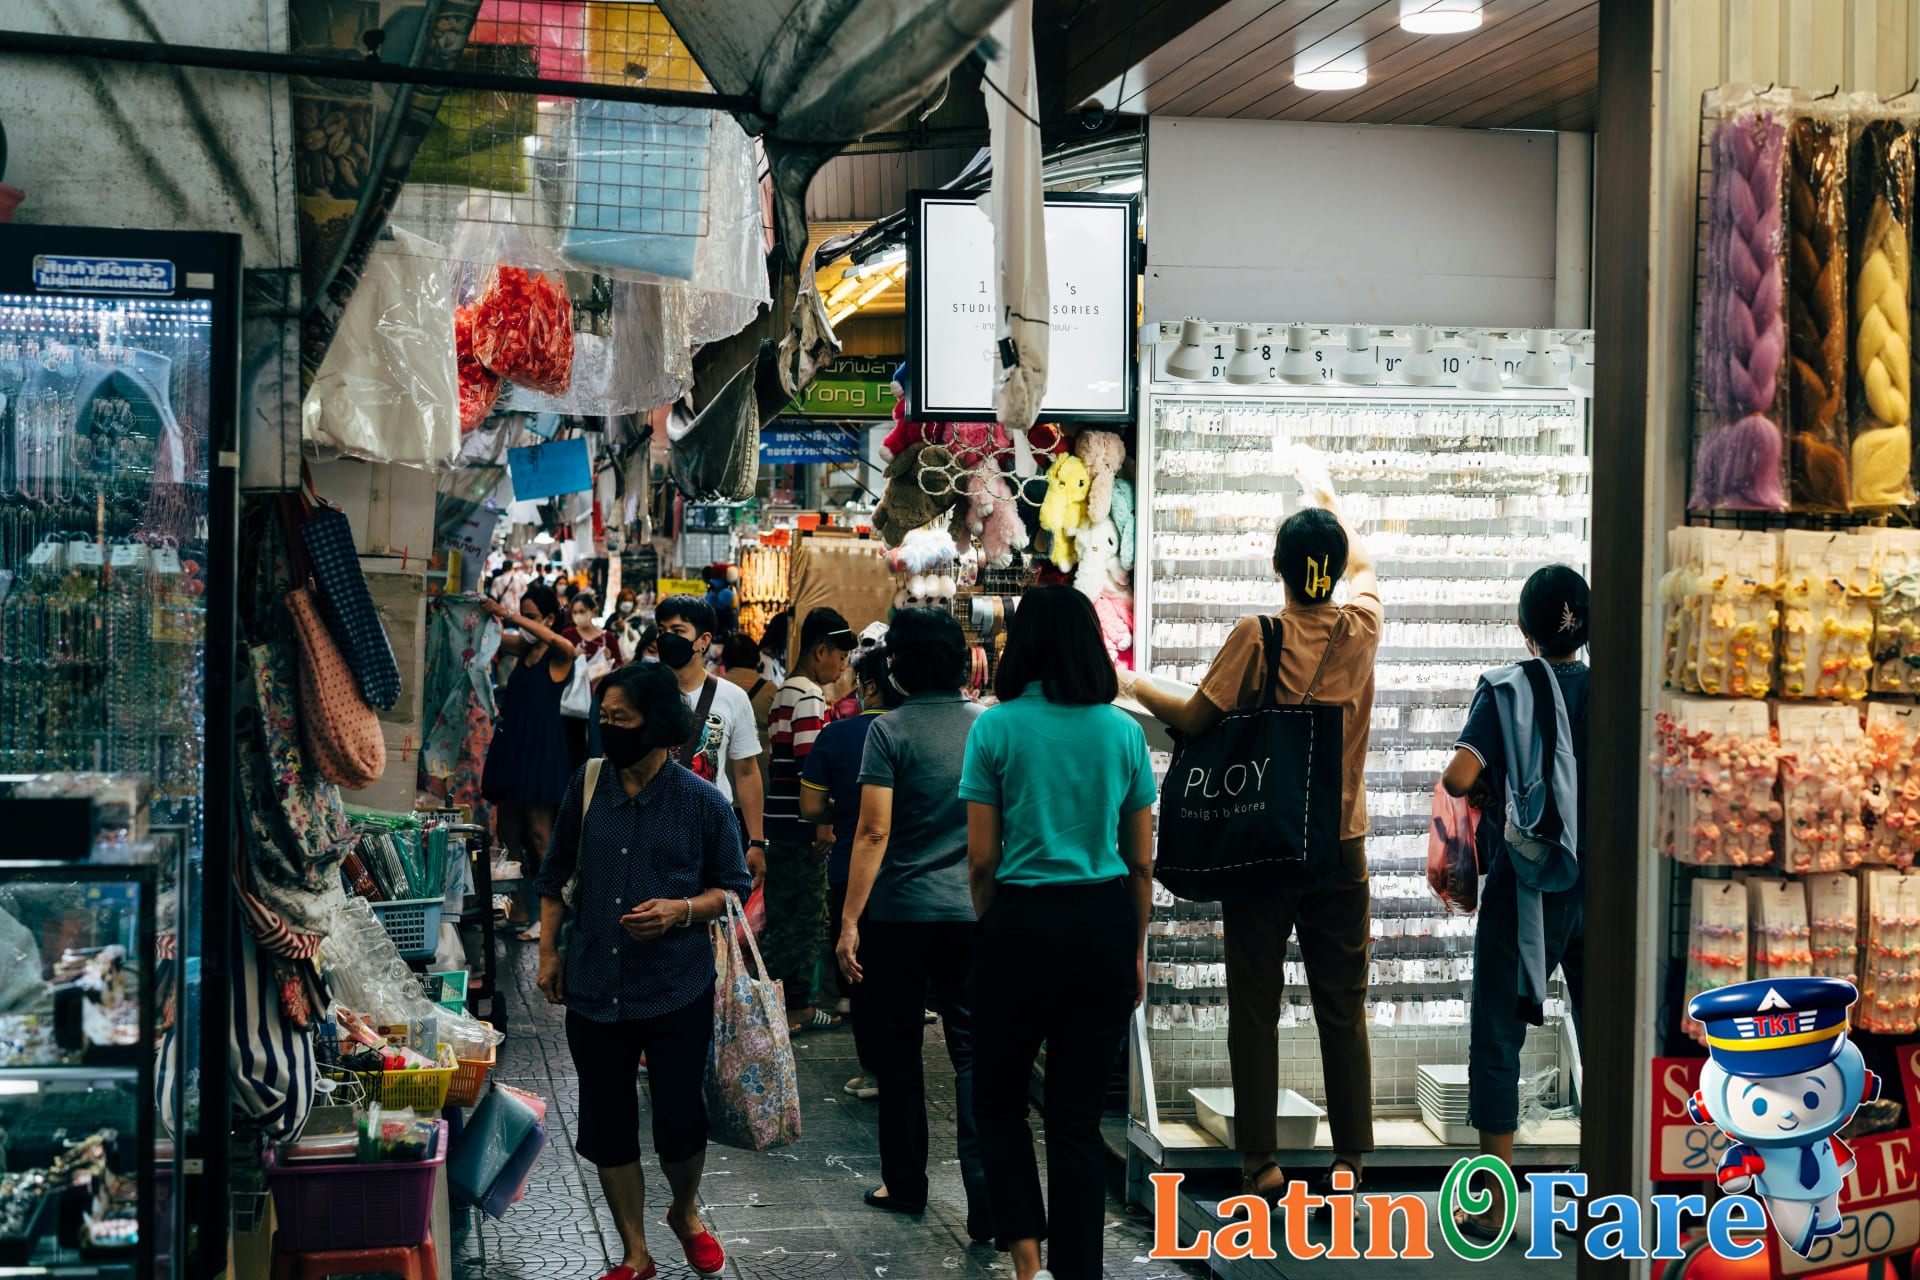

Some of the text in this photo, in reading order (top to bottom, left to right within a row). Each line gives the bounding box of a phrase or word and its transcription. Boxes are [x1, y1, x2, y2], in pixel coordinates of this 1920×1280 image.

[1052, 305, 1100, 315] SORIES
[805, 382, 866, 407] Yong
[1184, 757, 1271, 798] PLOY
[1234, 801, 1266, 814] korea
[1840, 1137, 1918, 1204] LE
